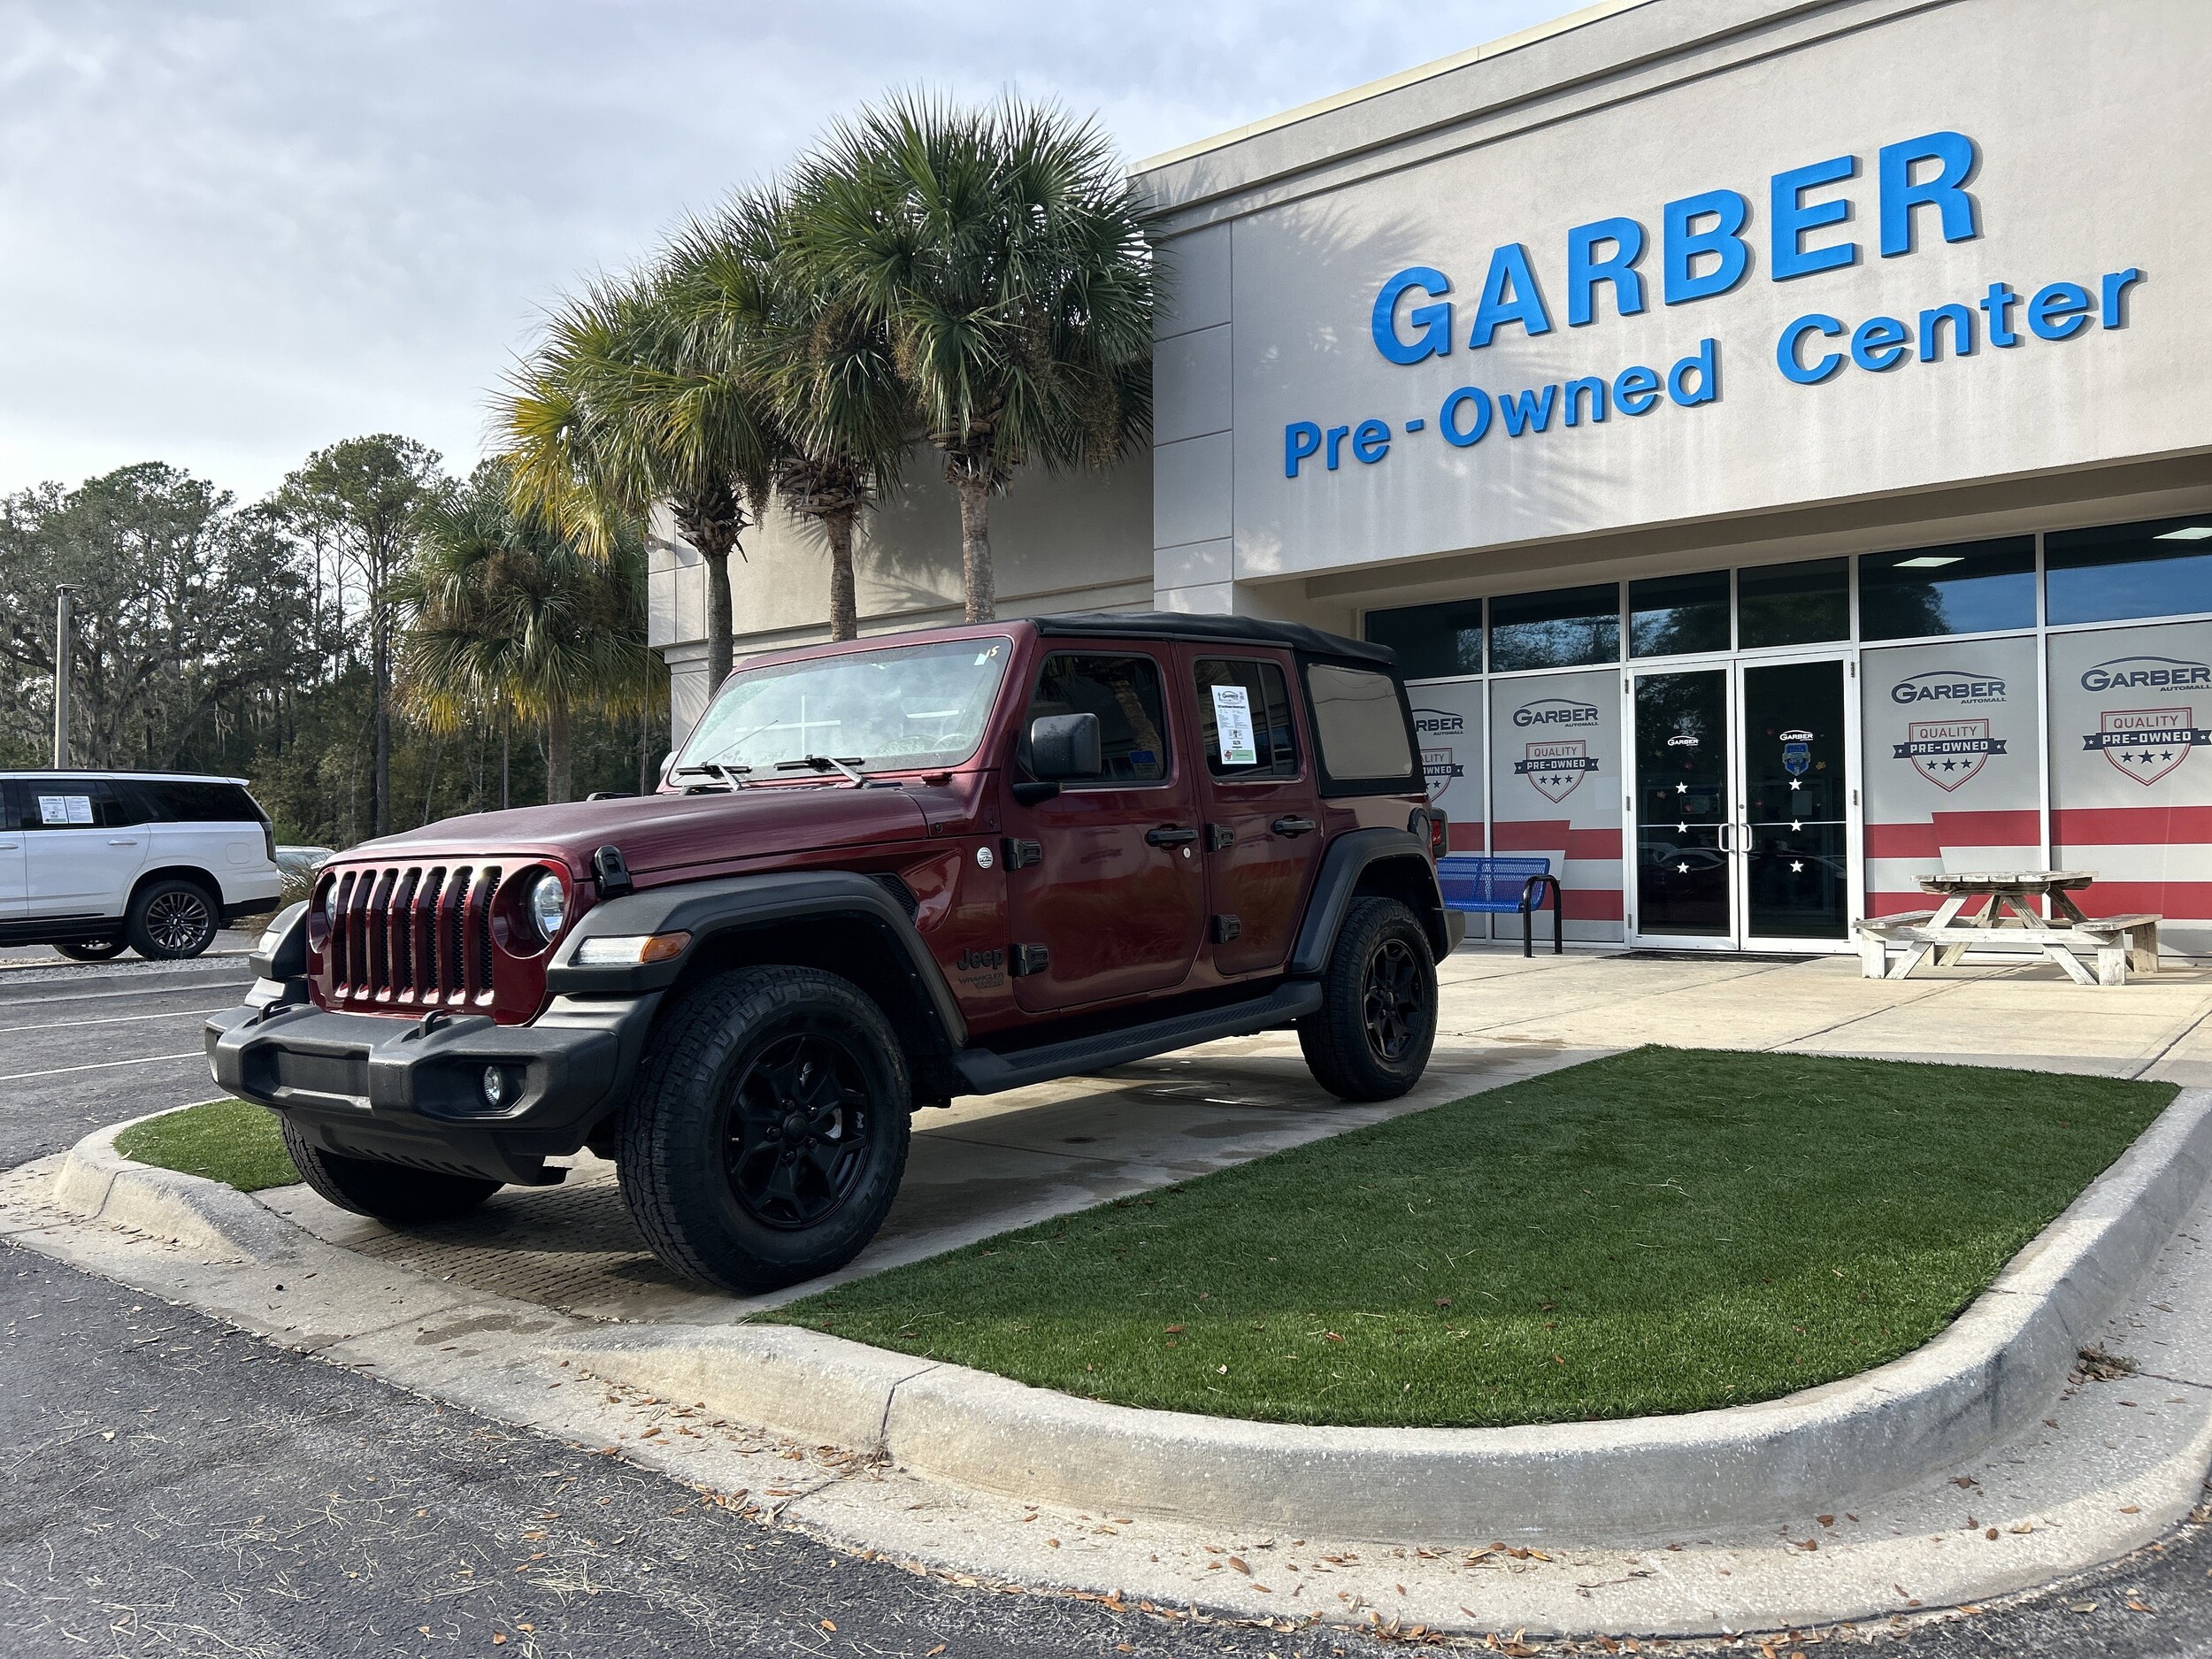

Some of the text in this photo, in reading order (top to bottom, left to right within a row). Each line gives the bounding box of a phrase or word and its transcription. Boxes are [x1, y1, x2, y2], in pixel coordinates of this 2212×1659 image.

[1371, 131, 1978, 366] GARBER
[1285, 267, 2141, 479] Pre-Owned Center
[2081, 667, 2211, 691] GARBER
[1891, 681, 2006, 704] GARBER
[1513, 708, 1598, 727] GARBER
[2113, 715, 2178, 729] QUALITY
[1416, 718, 1463, 733] RBER
[1920, 726, 1977, 739] QUALITY
[2102, 731, 2192, 745] PRE-OWNED
[1534, 746, 1578, 757] QUALITY
[1910, 741, 1989, 753] PRE-OWNED
[1422, 754, 1444, 763] LITY
[1526, 759, 1586, 770] PRE-OWNED
[956, 949, 1003, 971] Jeep
